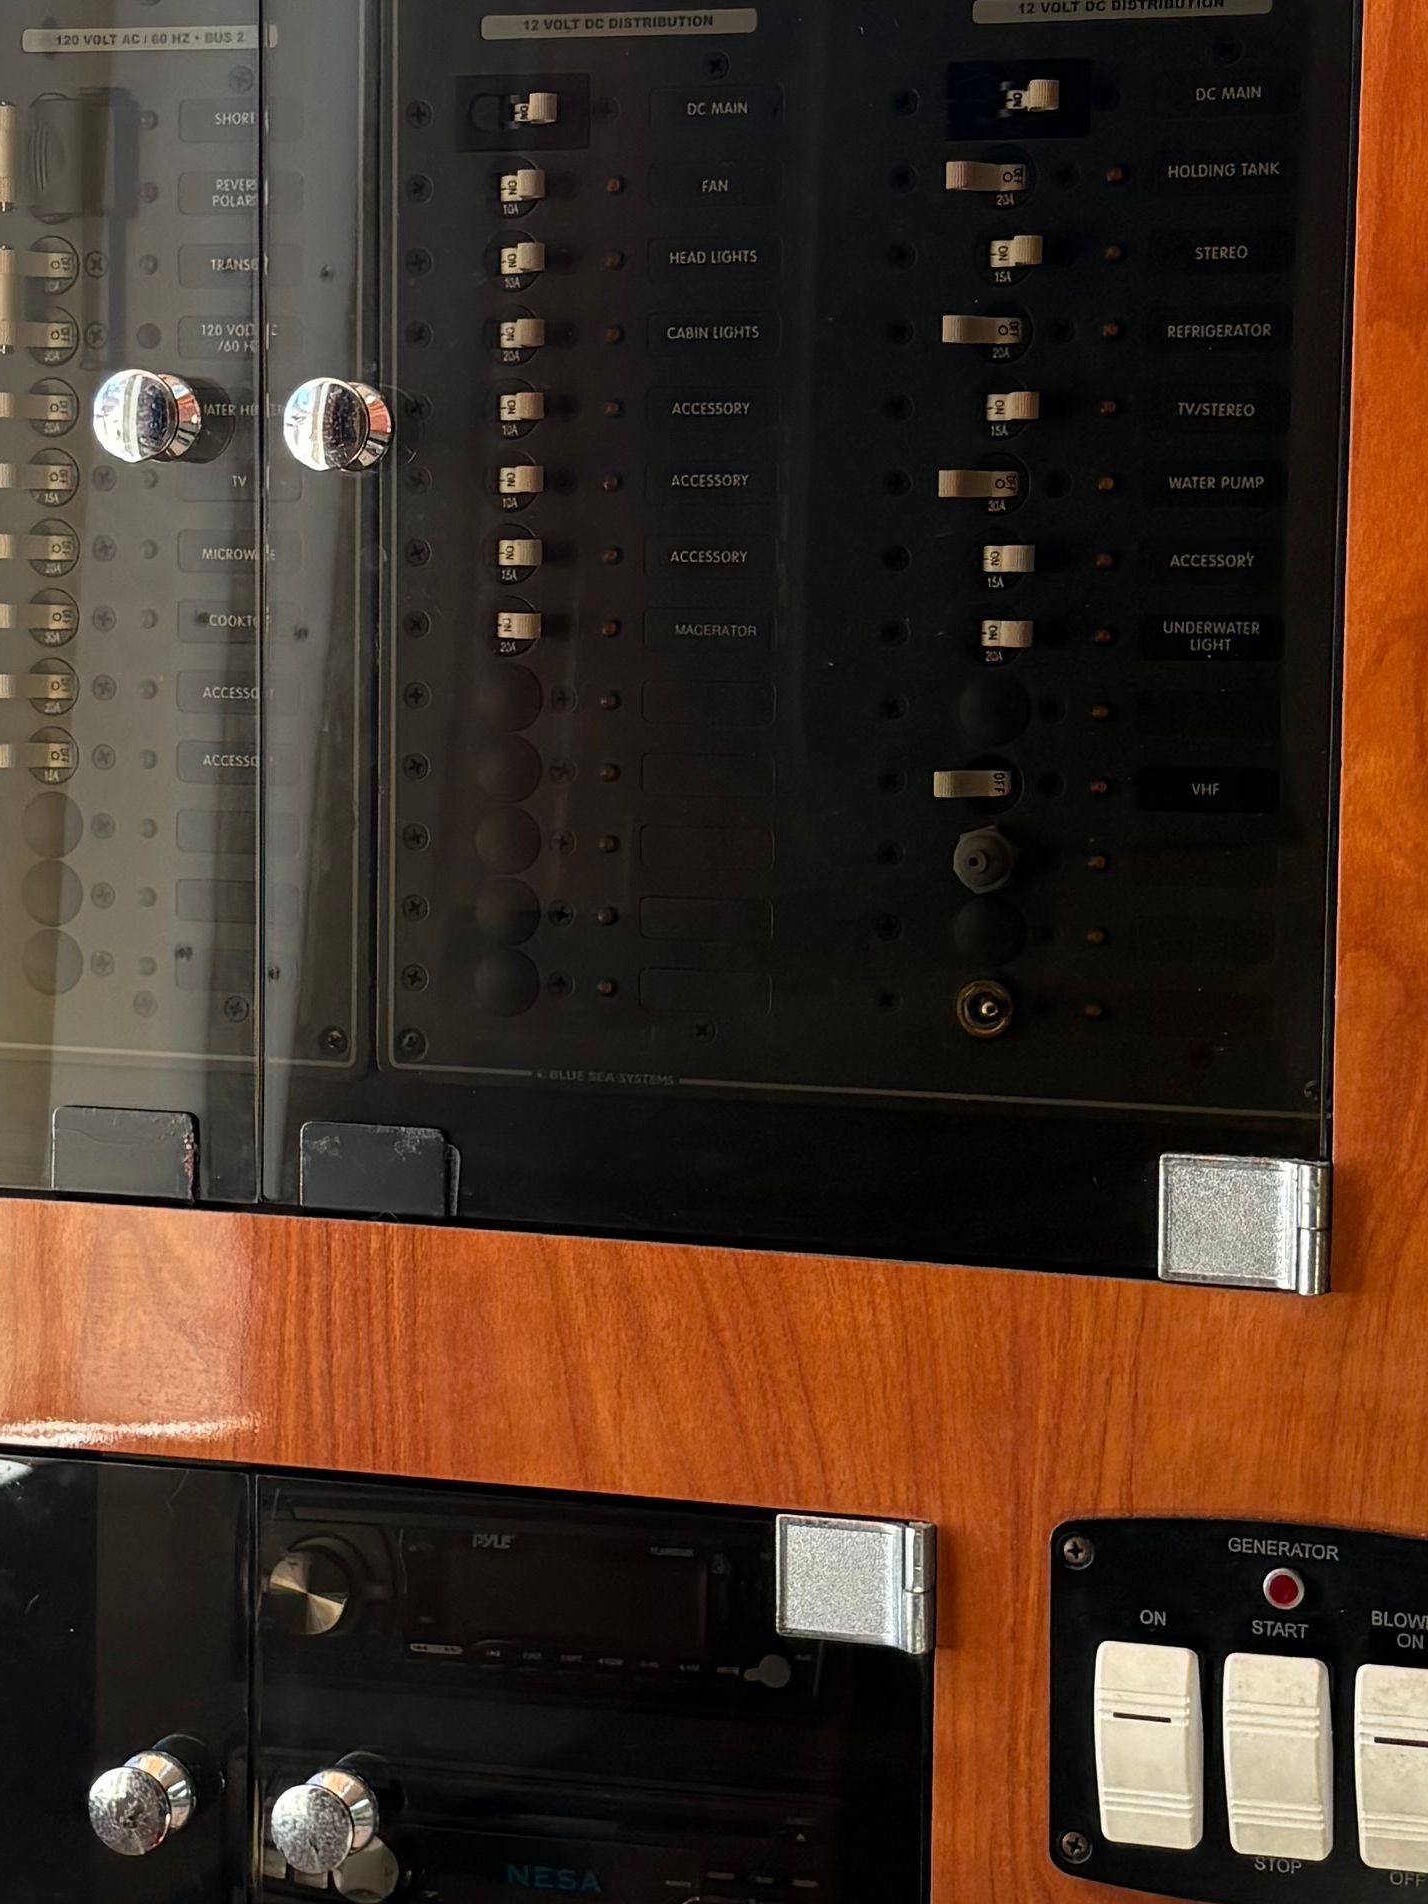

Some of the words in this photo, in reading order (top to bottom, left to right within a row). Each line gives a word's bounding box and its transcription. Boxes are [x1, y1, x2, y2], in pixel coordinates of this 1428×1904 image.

[1018, 2, 1036, 15] 12
[1040, 1, 1079, 15] VOLT
[1084, 0, 1107, 13] DC
[523, 18, 540, 32] 12
[543, 18, 580, 31] VOLT
[584, 17, 605, 30] DC
[608, 15, 714, 30] DISTRIBUTION
[56, 34, 79, 46] 120
[83, 33, 117, 46] VOLT
[122, 34, 141, 45] AC
[204, 32, 232, 44] BUS
[236, 32, 245, 43] 2
[1195, 88, 1218, 102] DC
[1221, 85, 1262, 100] MAIN
[686, 102, 708, 116] DC
[711, 101, 749, 115] MAIN
[1167, 163, 1236, 179] HOLDING
[1240, 161, 1281, 176] TANK
[508, 180, 517, 195] ON
[702, 179, 729, 193] FAN
[508, 254, 517, 268] ON
[669, 250, 707, 265] HEAD
[711, 249, 759, 264] LIGHTS
[999, 246, 1009, 262] ON
[1194, 246, 1249, 261] STEREO
[201, 324, 223, 337] 120
[666, 326, 709, 340] CABIN
[712, 325, 760, 339] LIGHTS
[1167, 323, 1272, 339] REFRIGERATOR
[508, 399, 516, 415] ON
[672, 401, 750, 416] ACCESSORY
[995, 399, 1004, 415] ON
[1177, 402, 1255, 417] TV/STEREO
[990, 425, 1008, 437] 15A
[232, 474, 248, 487] TV
[507, 472, 516, 487] ON
[671, 473, 749, 488] ACCESSORY
[1167, 476, 1216, 491] WATER
[1221, 475, 1265, 490] PUMP
[505, 545, 514, 560] ON
[670, 549, 748, 564] ACCESSORY
[990, 551, 1000, 567] ON
[1170, 552, 1254, 568] ACCESSORY
[675, 623, 757, 637] MACERATOR
[989, 625, 998, 640] ON
[1163, 620, 1260, 635] UNDERWATER
[1190, 638, 1232, 652] LIGHT
[994, 772, 1005, 794] OFF
[1191, 783, 1220, 797] VHF
[549, 1067, 584, 1080] BLUE
[588, 1069, 615, 1083] SEA
[619, 1071, 675, 1086] SYSTEMS
[472, 1532, 517, 1550] PYLE
[1227, 1537, 1340, 1561] GENERATOR
[1139, 1609, 1167, 1626] ON
[1251, 1619, 1309, 1639] START
[1396, 1633, 1424, 1650] ON
[1254, 1857, 1302, 1875] STOP
[507, 1863, 602, 1894] NESA
[1390, 1871, 1426, 1887] OFF
